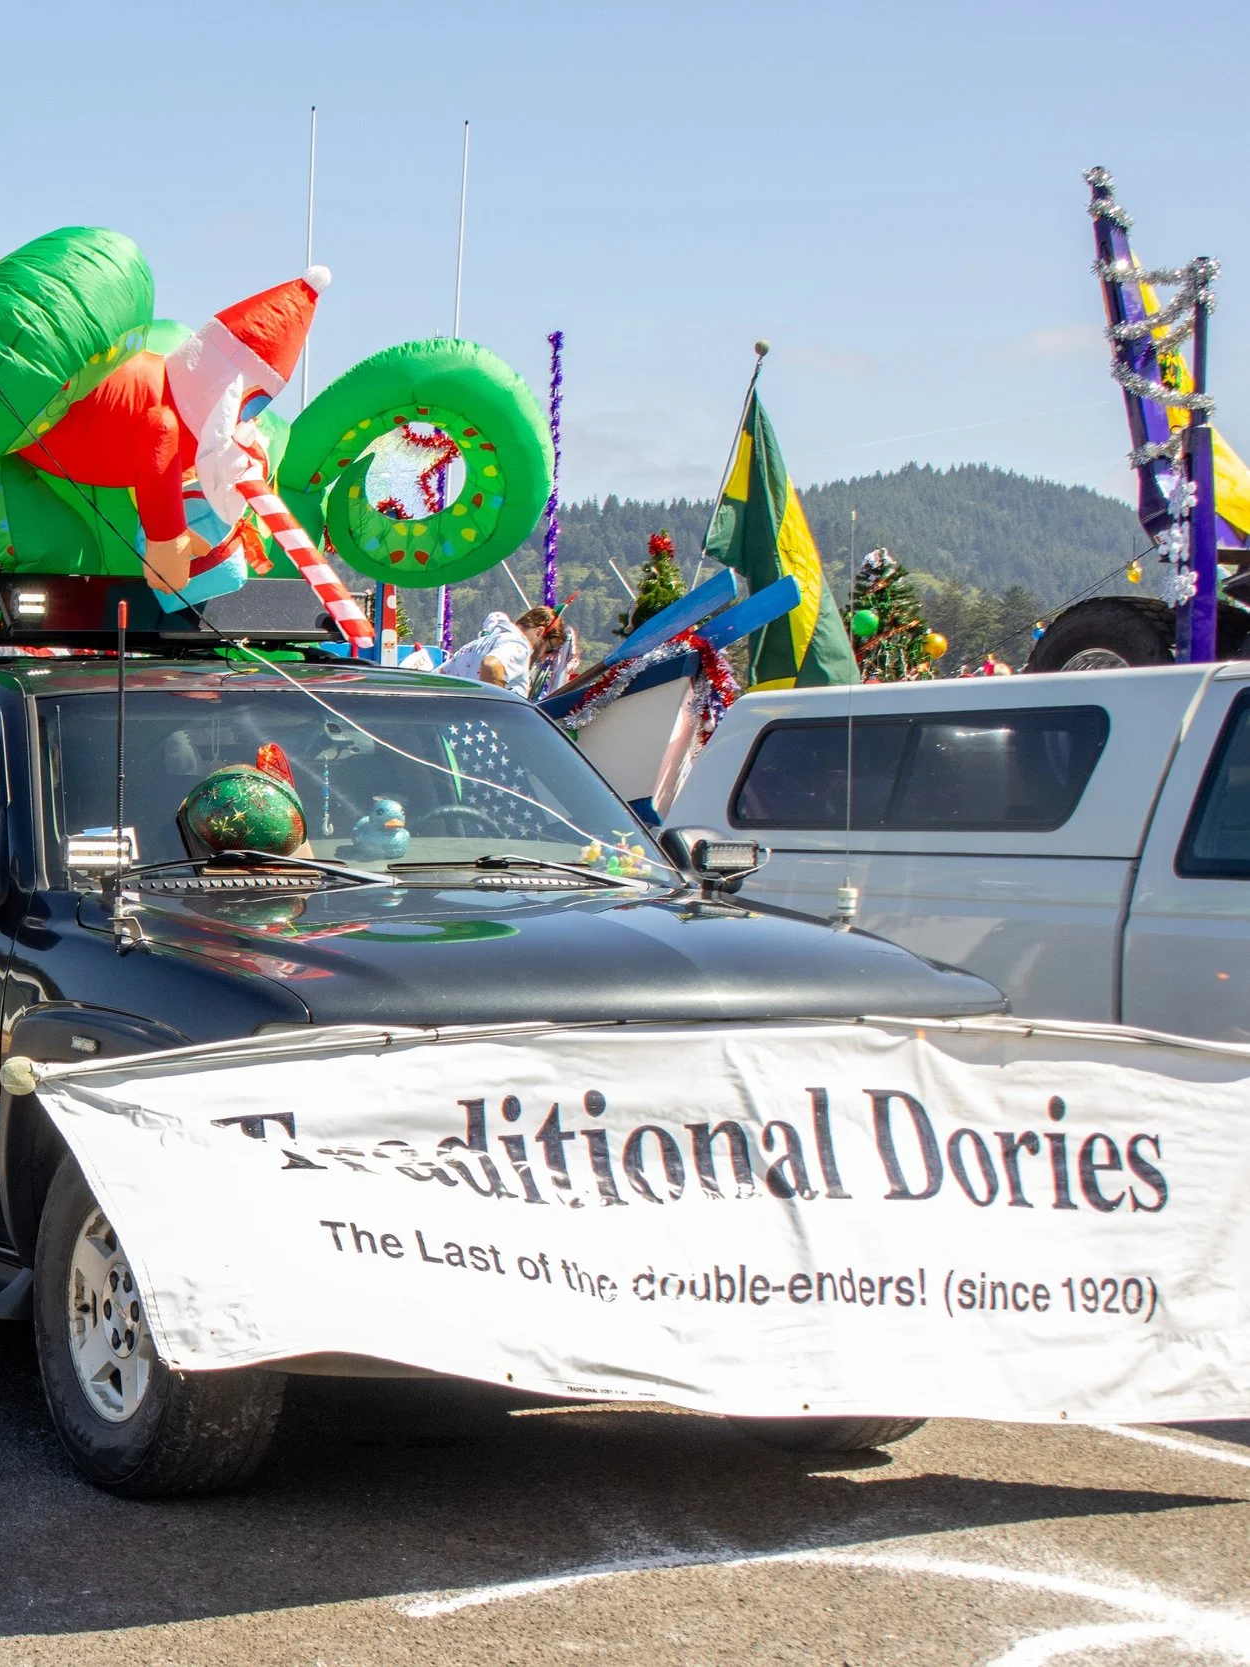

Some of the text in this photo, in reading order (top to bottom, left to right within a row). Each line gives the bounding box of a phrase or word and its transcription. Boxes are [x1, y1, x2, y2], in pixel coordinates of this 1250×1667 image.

[862, 1088, 1169, 1214] Dories
[319, 1220, 1159, 1324] The Last of the double-enders! (since 1920)
